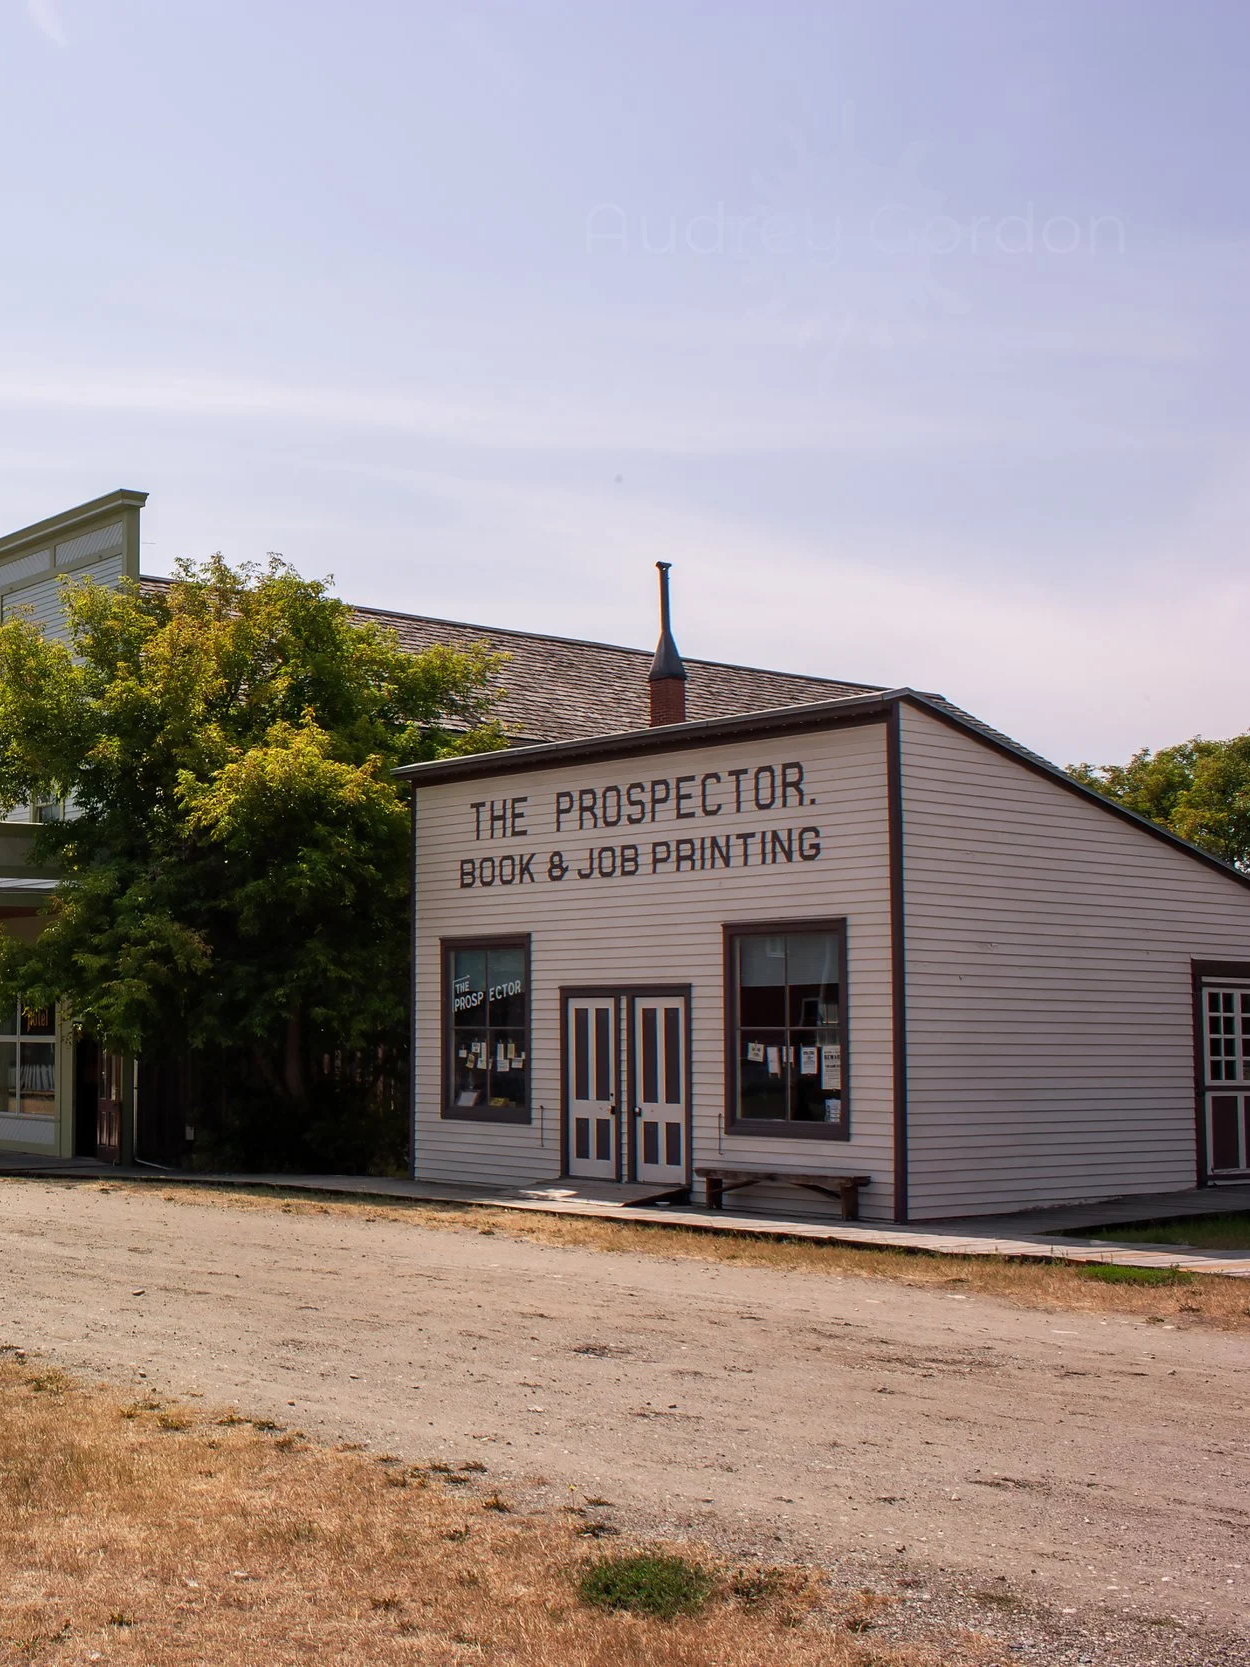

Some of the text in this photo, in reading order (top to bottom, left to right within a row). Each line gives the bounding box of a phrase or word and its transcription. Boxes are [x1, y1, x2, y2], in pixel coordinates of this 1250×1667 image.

[470, 761, 817, 840] THE PROSPECTOR.
[460, 826, 822, 888] BOOK & JOB PRINTING
[455, 981, 470, 995] THE
